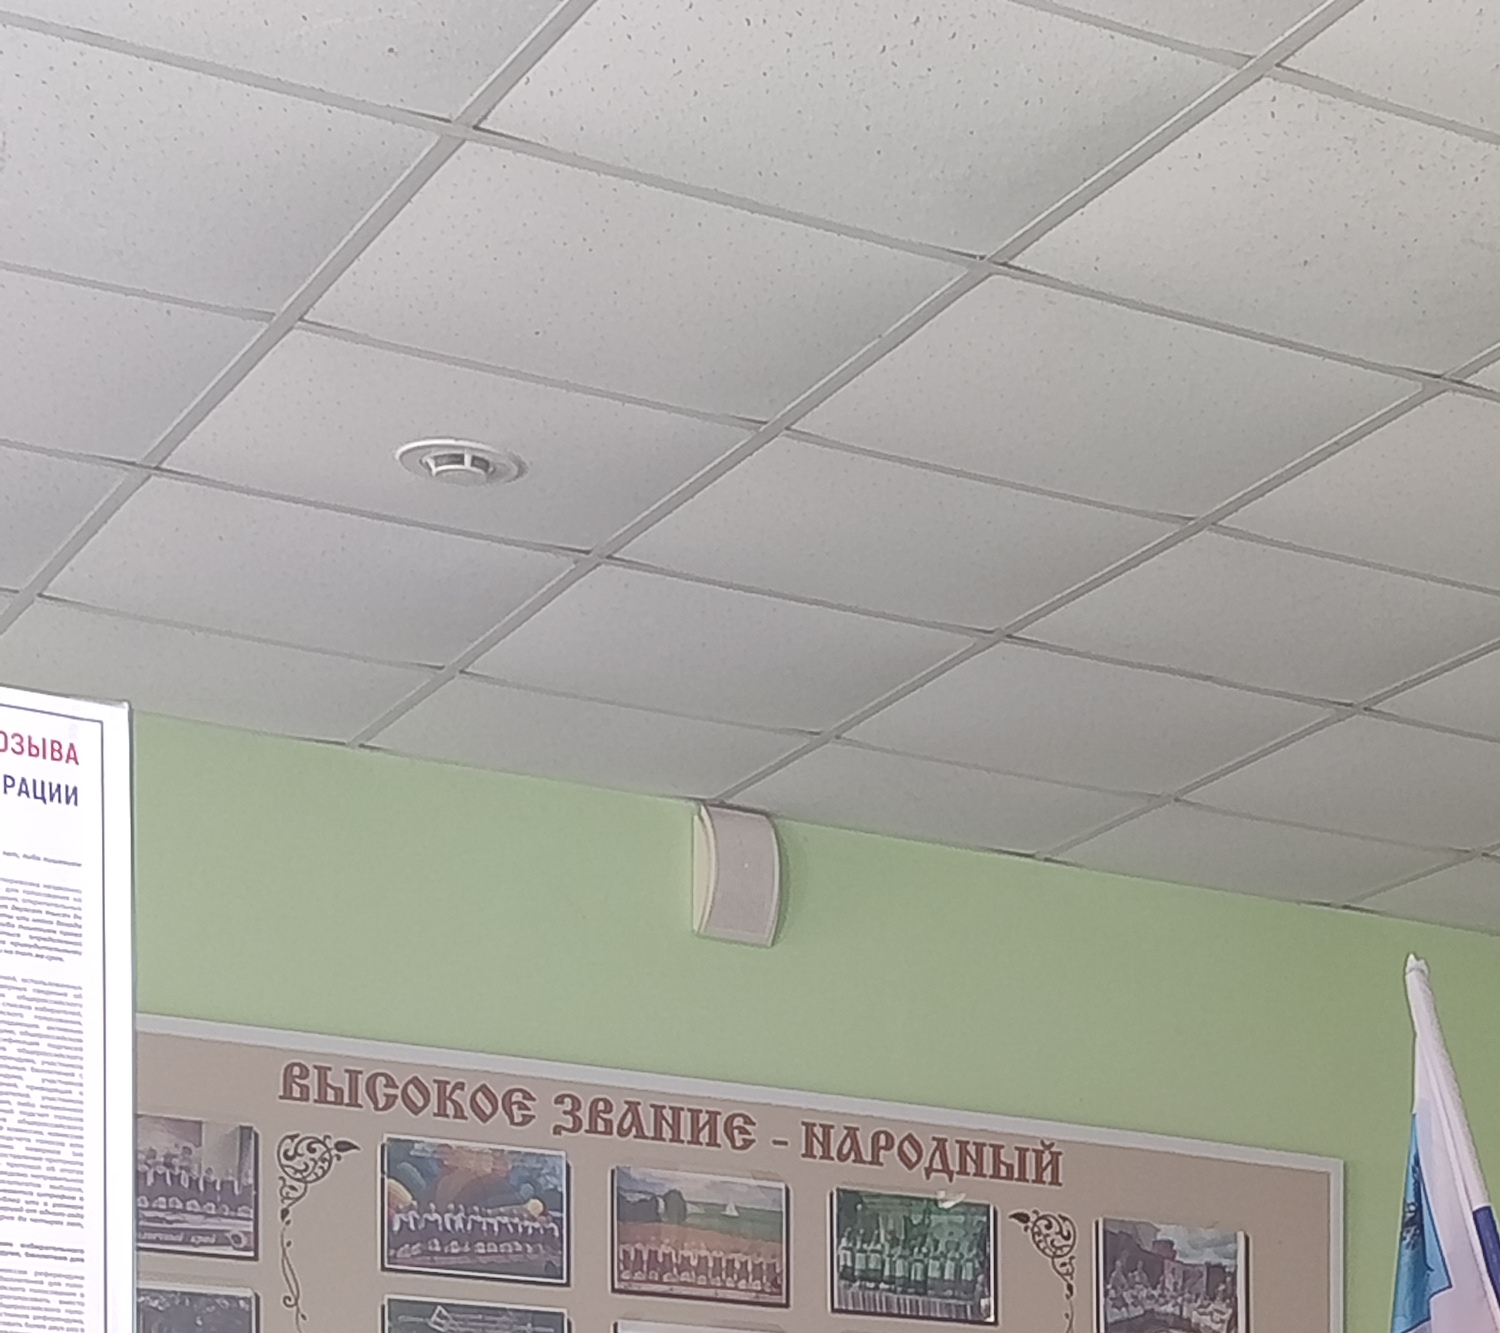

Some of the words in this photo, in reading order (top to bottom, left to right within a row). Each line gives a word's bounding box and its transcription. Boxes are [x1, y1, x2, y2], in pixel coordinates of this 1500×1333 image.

[3, 773, 79, 807] РАЦИИ
[278, 1061, 537, 1127] ВЫСОКОЕ
[552, 1093, 757, 1151] ЗВАНИЕ
[800, 1120, 1064, 1187] НАРОДНЫЙ
